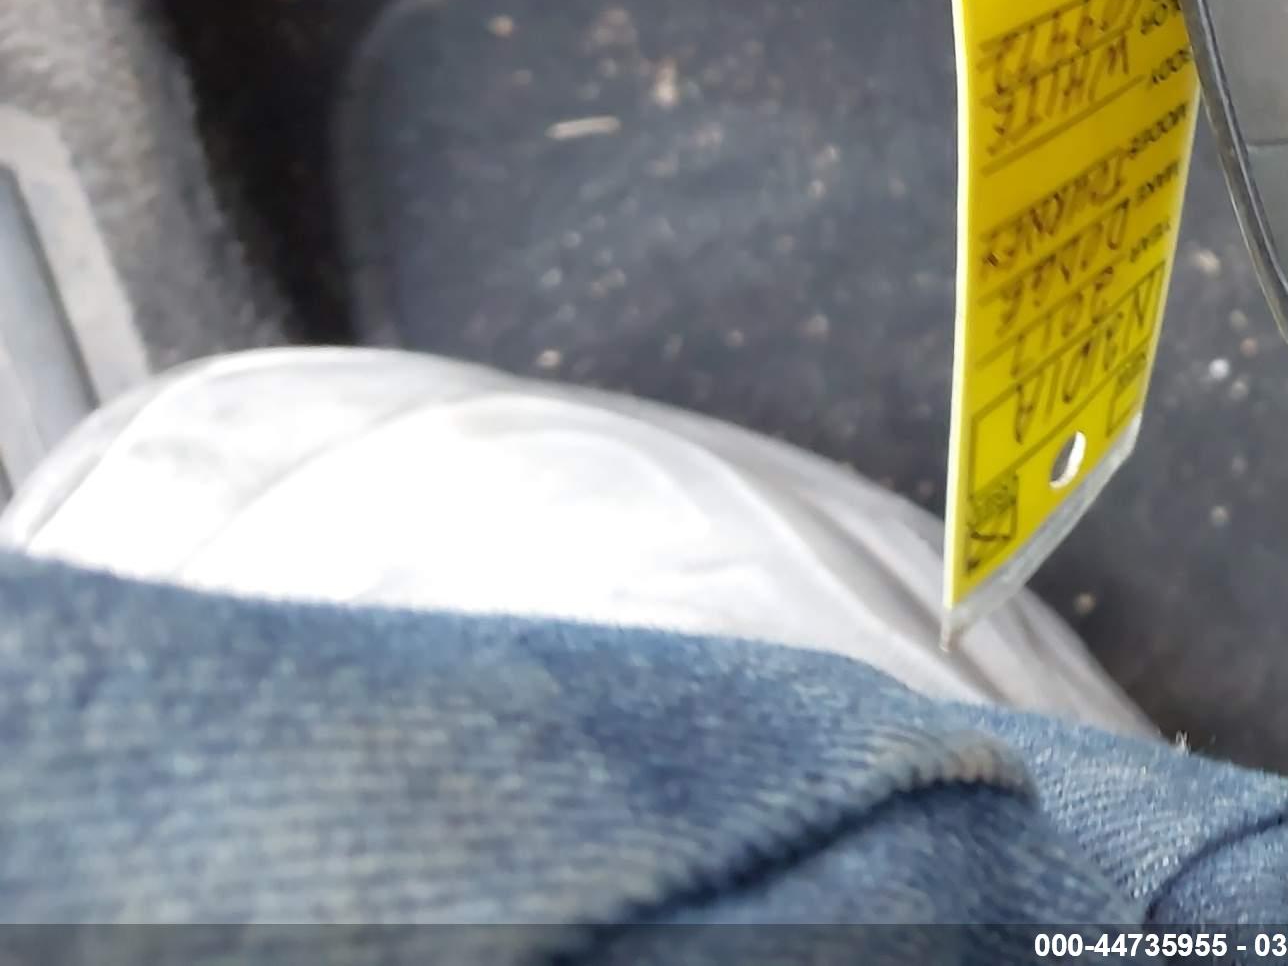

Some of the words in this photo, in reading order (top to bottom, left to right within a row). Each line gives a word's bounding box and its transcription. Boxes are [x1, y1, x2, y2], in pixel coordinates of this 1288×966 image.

[987, 34, 1129, 156] WHITE
[1136, 160, 1180, 208] MAKE
[995, 198, 1130, 339] DODGE
[1011, 265, 1113, 378] 2017
